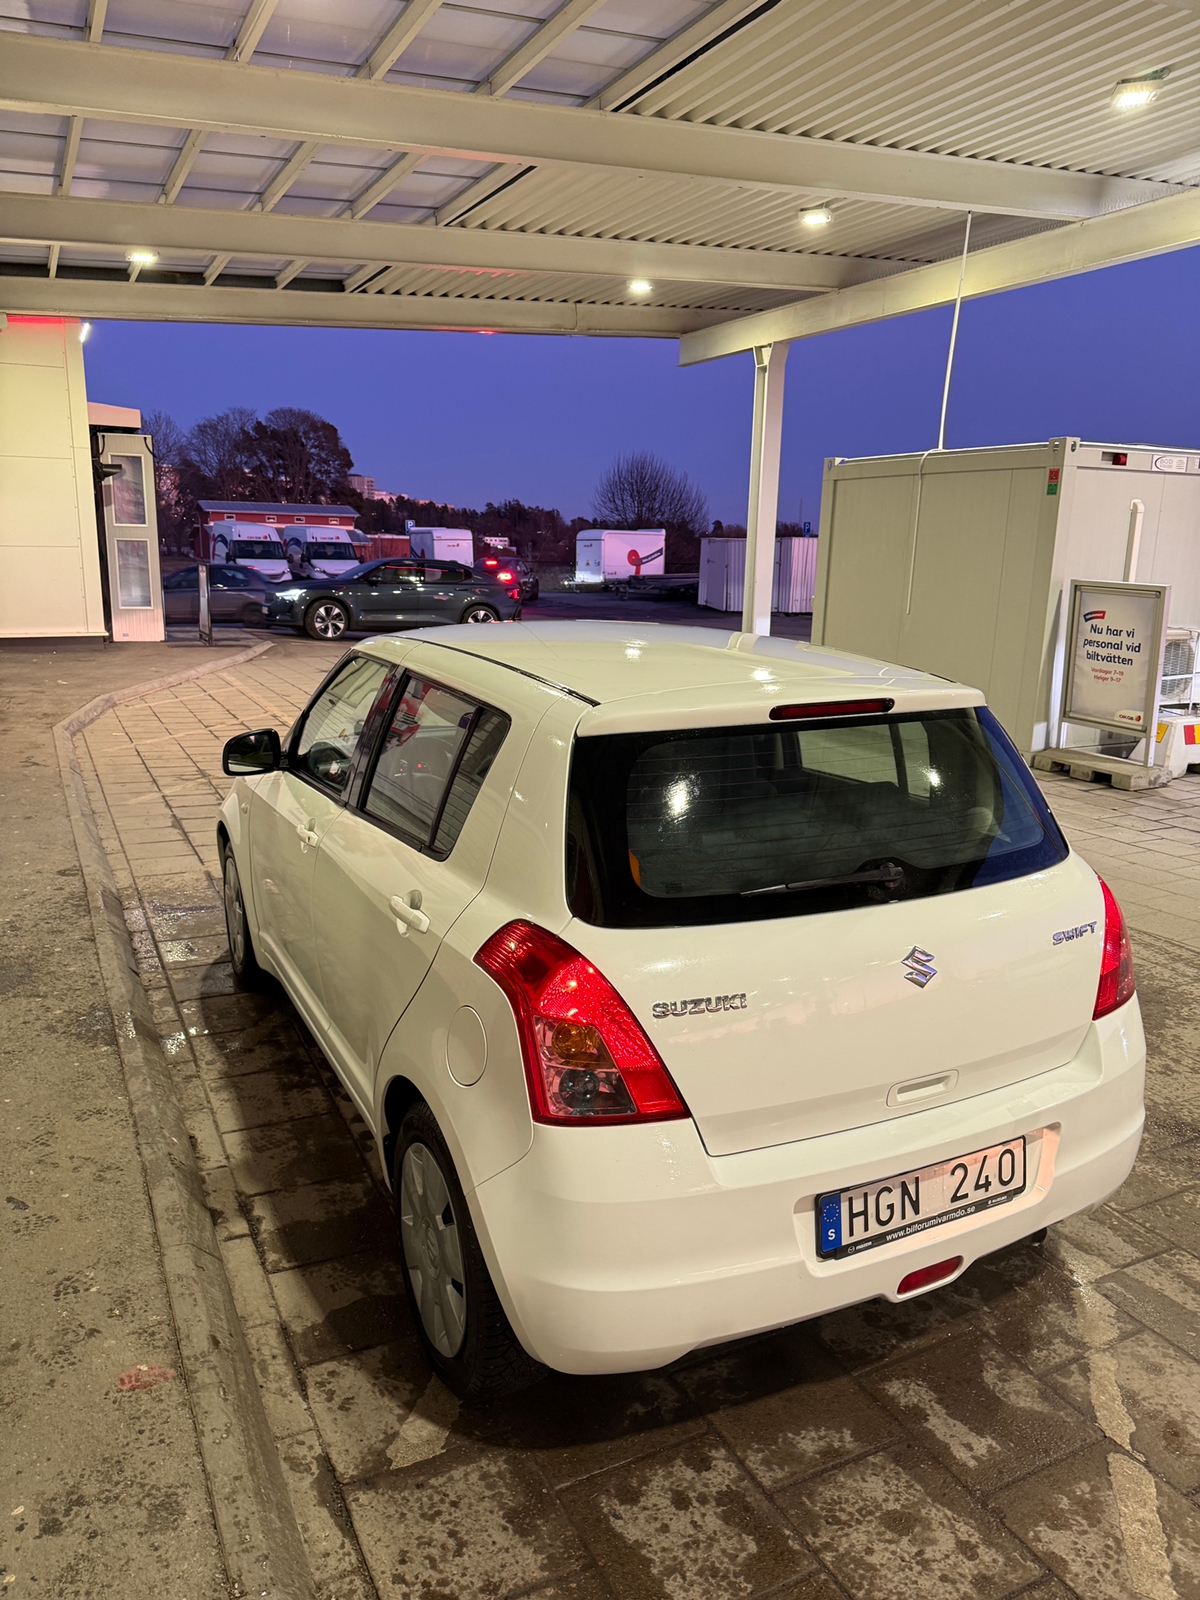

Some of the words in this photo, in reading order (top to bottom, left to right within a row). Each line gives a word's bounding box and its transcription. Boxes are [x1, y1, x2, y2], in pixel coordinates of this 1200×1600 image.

[1090, 623, 1103, 635] Nu
[1106, 625, 1123, 637] har
[1126, 628, 1135, 638] vi
[1083, 638, 1123, 651] personal
[1126, 642, 1141, 653] vid
[1086, 650, 1133, 666] biltvätten
[1052, 920, 1097, 946] SWIFT
[652, 993, 748, 1019] SUZUKI
[848, 1175, 920, 1237] HGN
[950, 1148, 1015, 1204] 240
[886, 1205, 976, 1241] www.bilforumivarmdo.se
[828, 1228, 836, 1241] S
